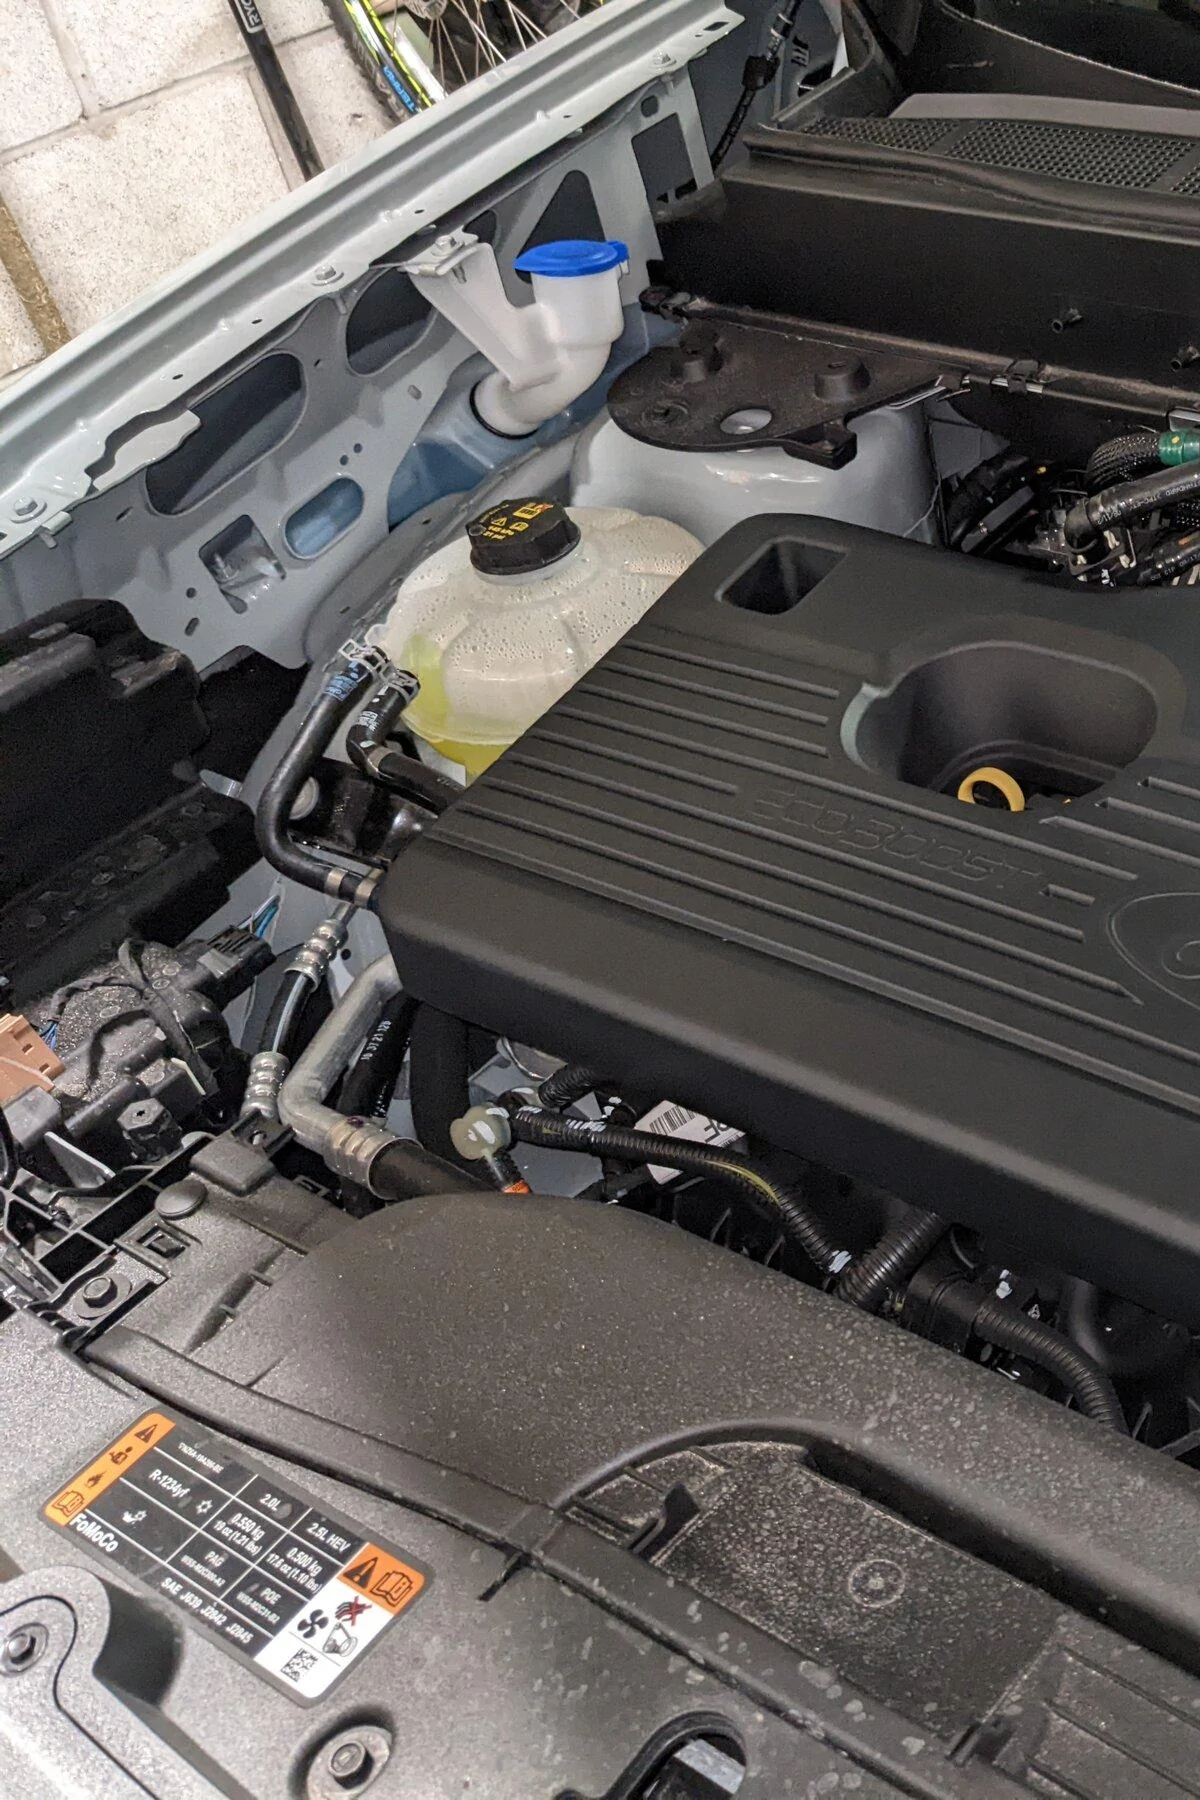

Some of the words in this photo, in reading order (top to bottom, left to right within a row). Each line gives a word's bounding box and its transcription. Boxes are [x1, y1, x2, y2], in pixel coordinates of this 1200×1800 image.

[148, 1468, 191, 1498] R-1234yf
[259, 1493, 282, 1511] 2.0L
[69, 1513, 119, 1552] FoMoCo
[213, 1520, 227, 1532] 19
[231, 1512, 258, 1537] 0.550
[251, 1525, 266, 1541] kg
[307, 1522, 329, 1541] 2.5L
[325, 1532, 351, 1553] HEV
[266, 1553, 285, 1568] 17.6
[286, 1547, 313, 1568] 0.500
[307, 1560, 323, 1577] kg
[161, 1577, 183, 1595] SAE
